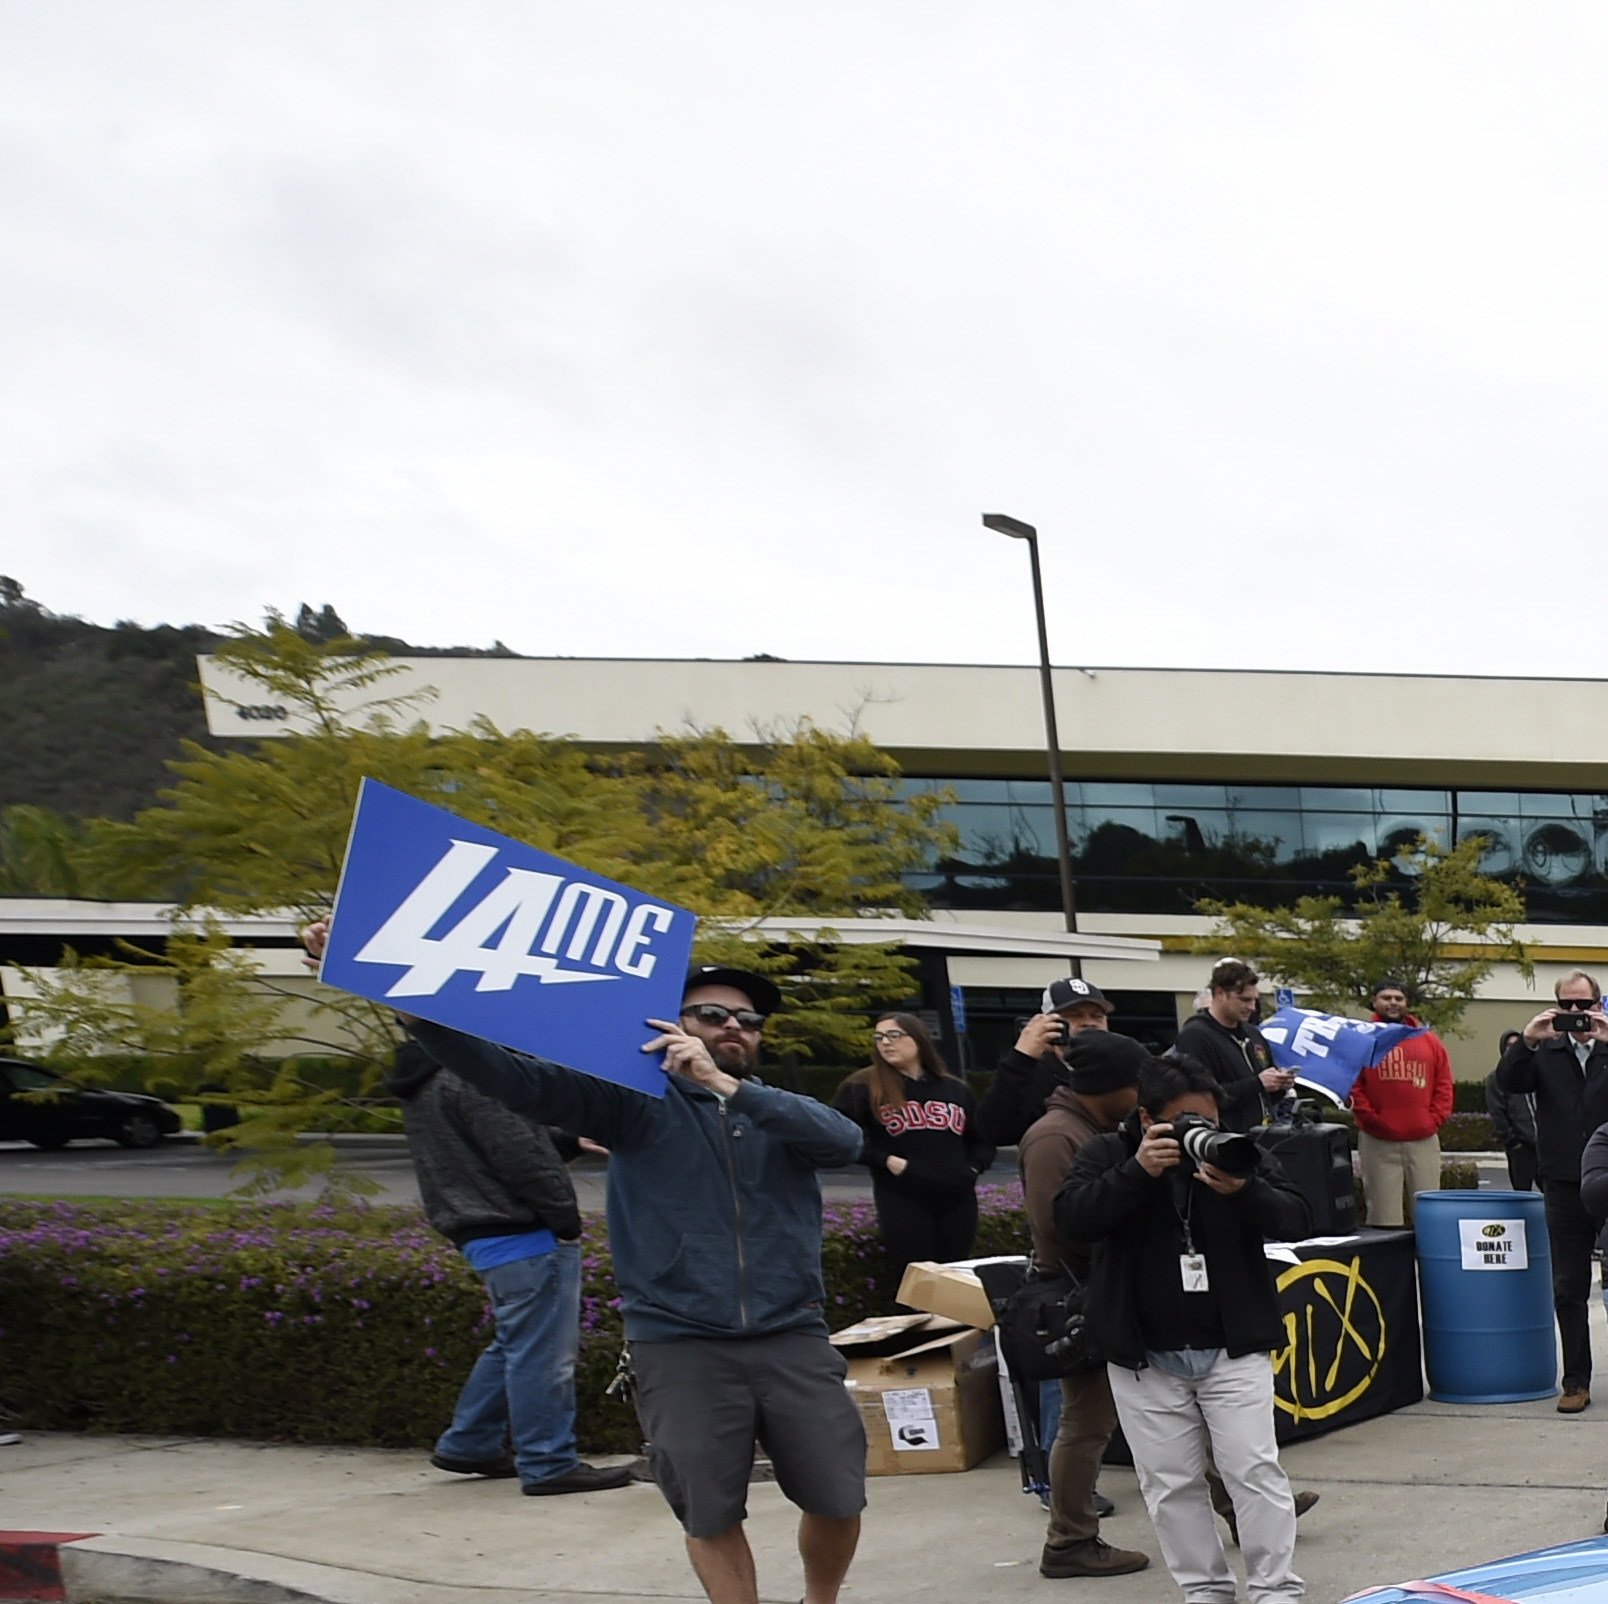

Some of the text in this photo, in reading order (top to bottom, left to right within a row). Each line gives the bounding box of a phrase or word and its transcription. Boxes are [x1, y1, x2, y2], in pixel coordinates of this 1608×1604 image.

[353, 839, 674, 998] LAME
[880, 1100, 967, 1137] SDSU
[1475, 1241, 1512, 1252] DONATE
[1483, 1253, 1507, 1265] HERE
